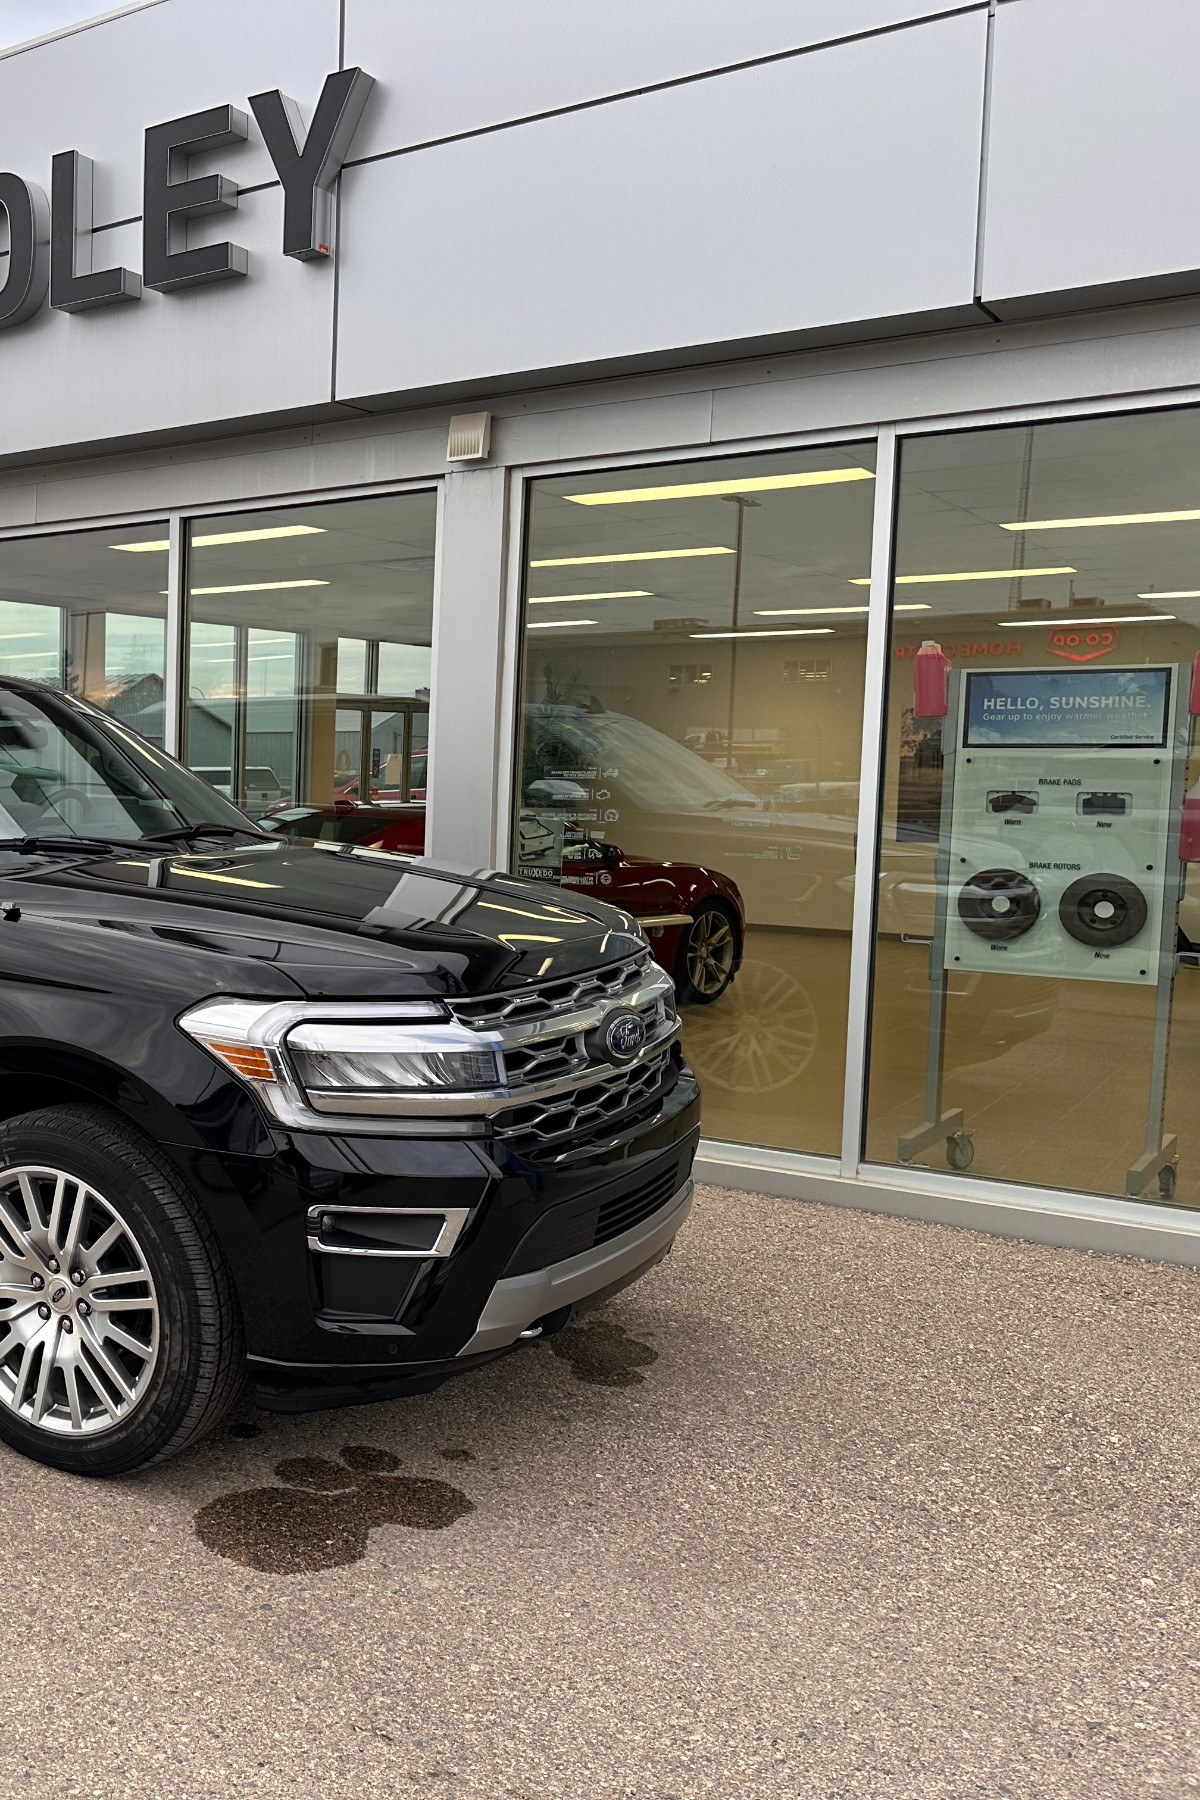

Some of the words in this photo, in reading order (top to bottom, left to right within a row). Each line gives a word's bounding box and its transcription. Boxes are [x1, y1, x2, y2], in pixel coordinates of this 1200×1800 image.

[983, 697, 1044, 711] HELLO,
[1049, 695, 1151, 709] SUNSHINE.
[1008, 714, 1020, 722] up
[1035, 712, 1063, 722] enjoy
[1065, 712, 1103, 721] warmer
[1038, 778, 1061, 786] BRAKE
[1063, 778, 1082, 787] PADS
[1004, 818, 1022, 826] Worn
[1028, 862, 1052, 870] BRAKE
[1053, 862, 1081, 871] ROTORS
[990, 943, 1008, 952] Worn
[1094, 951, 1111, 959] New
